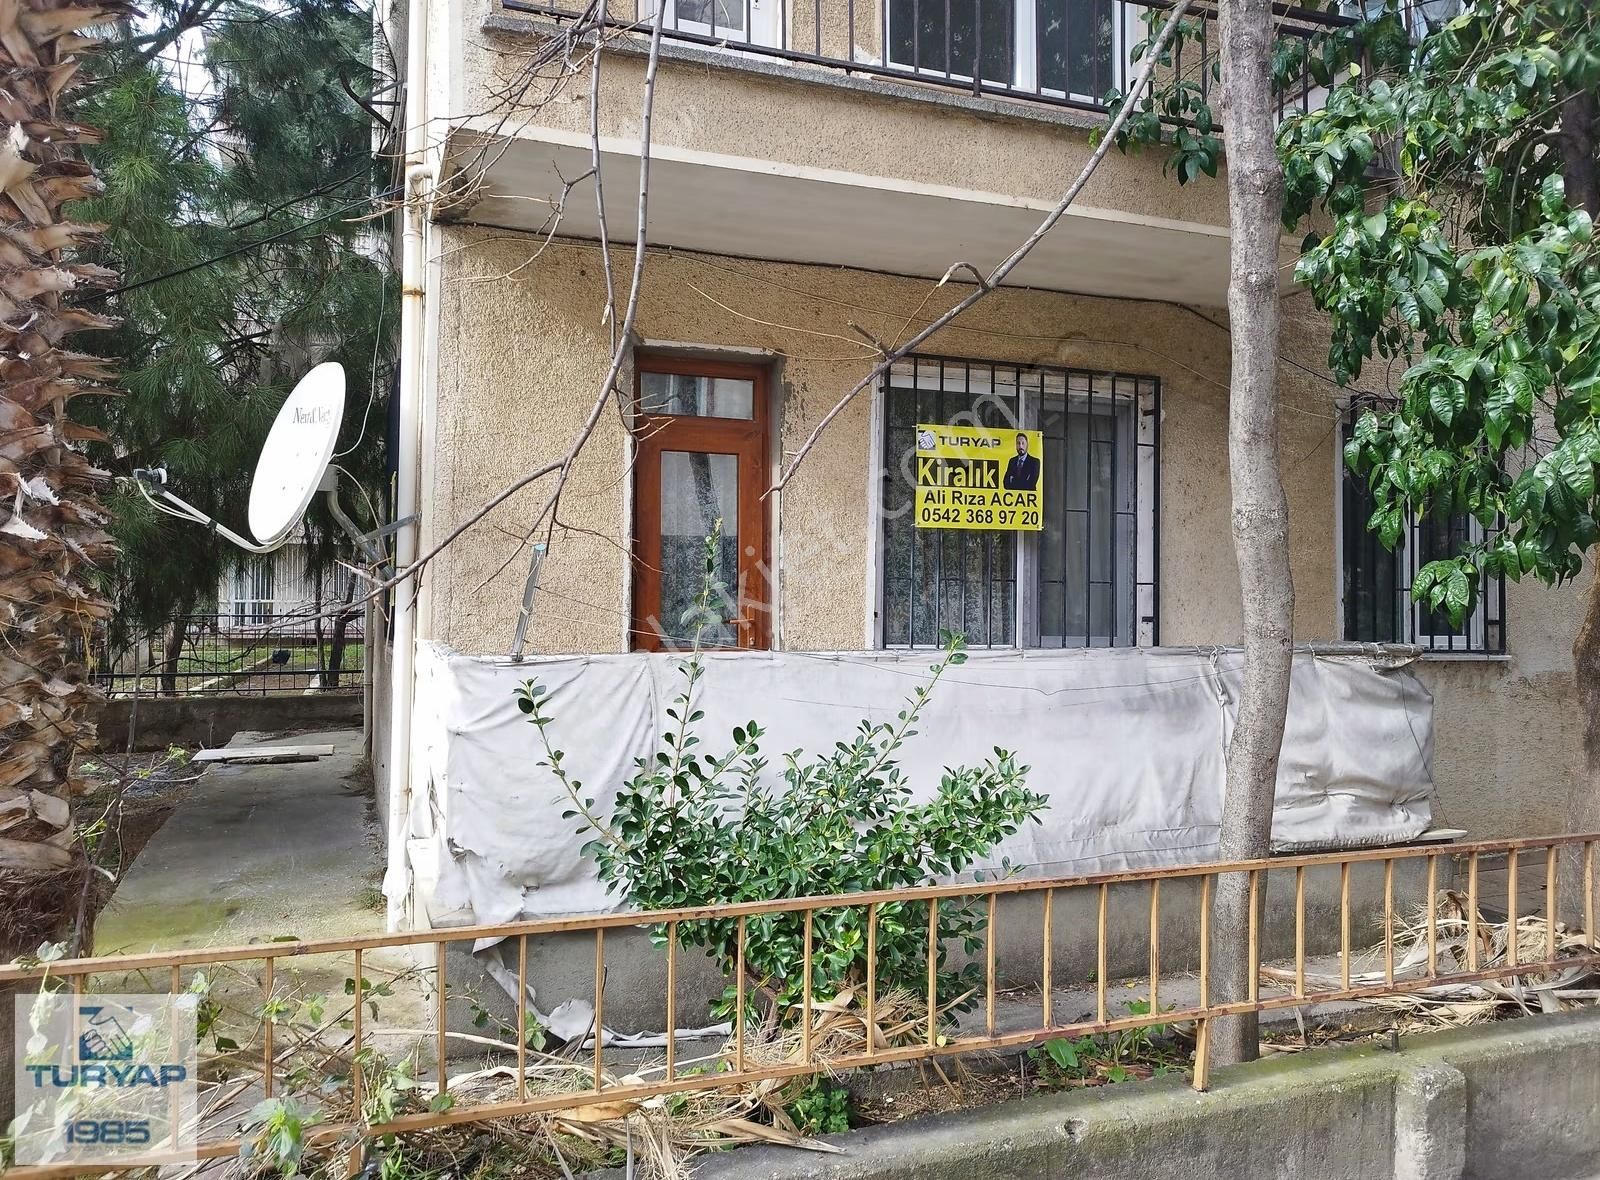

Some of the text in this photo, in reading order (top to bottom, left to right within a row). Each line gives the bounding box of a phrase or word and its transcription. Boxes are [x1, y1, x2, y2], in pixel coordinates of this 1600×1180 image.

[938, 435, 1001, 448] TURYAP
[918, 458, 997, 488] Kiralık
[924, 490, 1038, 508] Ali Rıza ACAR
[922, 508, 1039, 525] 0542 368 97 20
